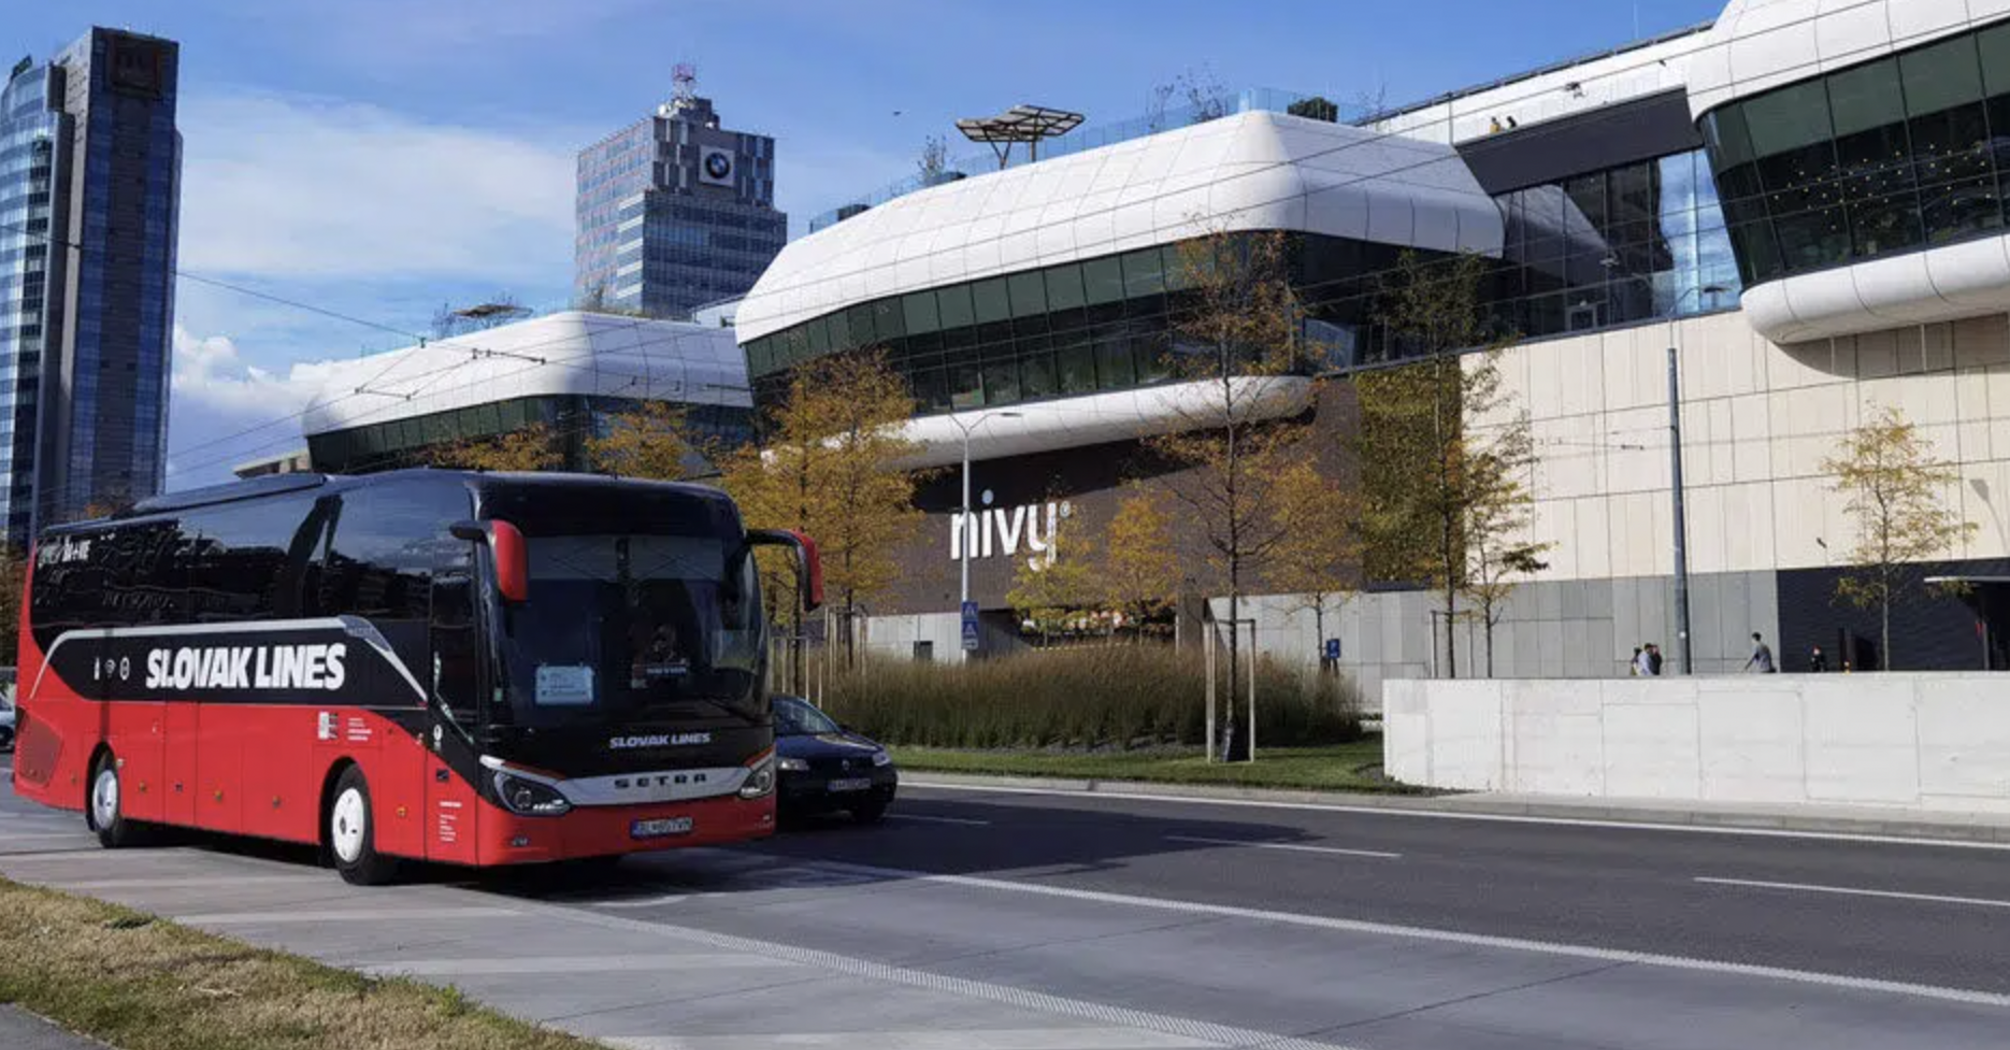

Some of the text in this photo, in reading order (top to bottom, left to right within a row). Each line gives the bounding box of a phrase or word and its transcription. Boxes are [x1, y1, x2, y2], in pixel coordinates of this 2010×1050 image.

[146, 643, 346, 690] SLOVAK LINES
[609, 733, 711, 749] SLOVAK LINES
[614, 773, 707, 789] SETRA
